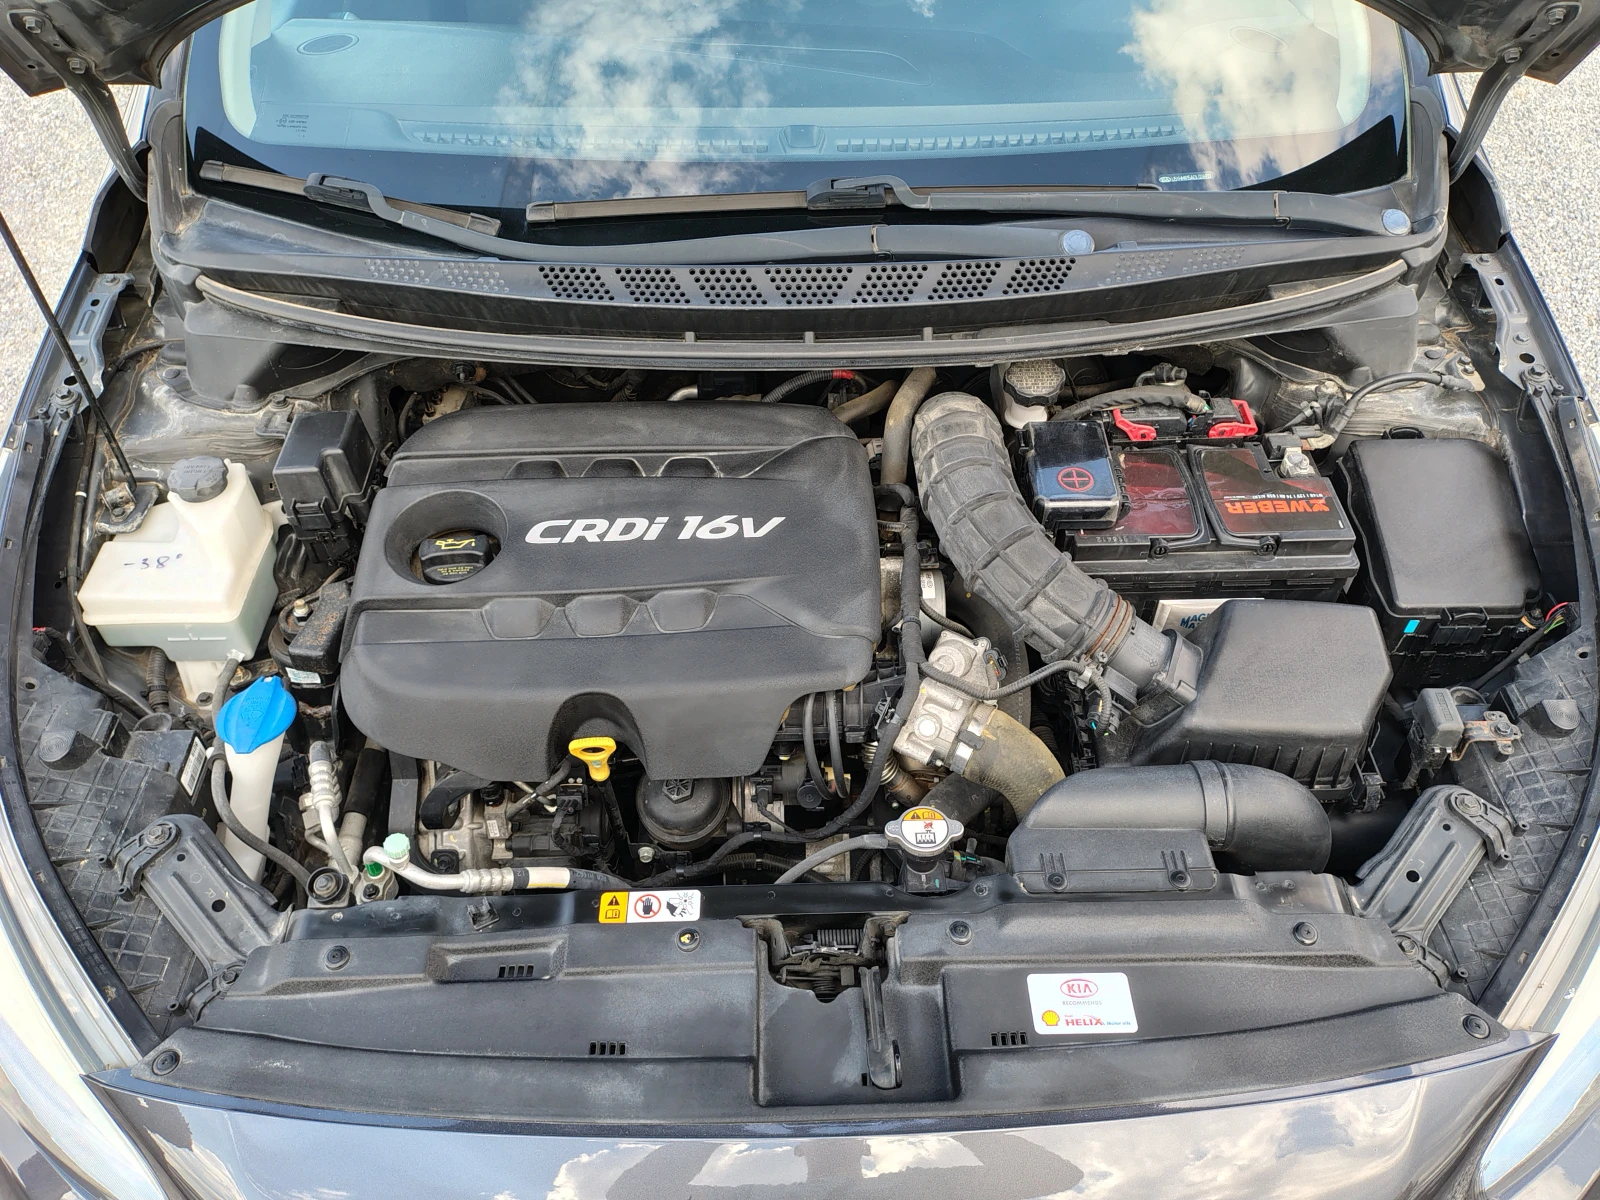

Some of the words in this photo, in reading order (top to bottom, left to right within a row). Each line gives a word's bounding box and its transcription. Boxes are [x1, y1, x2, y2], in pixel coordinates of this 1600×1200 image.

[1225, 501, 1313, 514] WEBER
[524, 516, 670, 544] CRDi
[677, 514, 787, 540] 16V
[1066, 983, 1093, 994] KIA
[1065, 1018, 1104, 1026] HELIX
